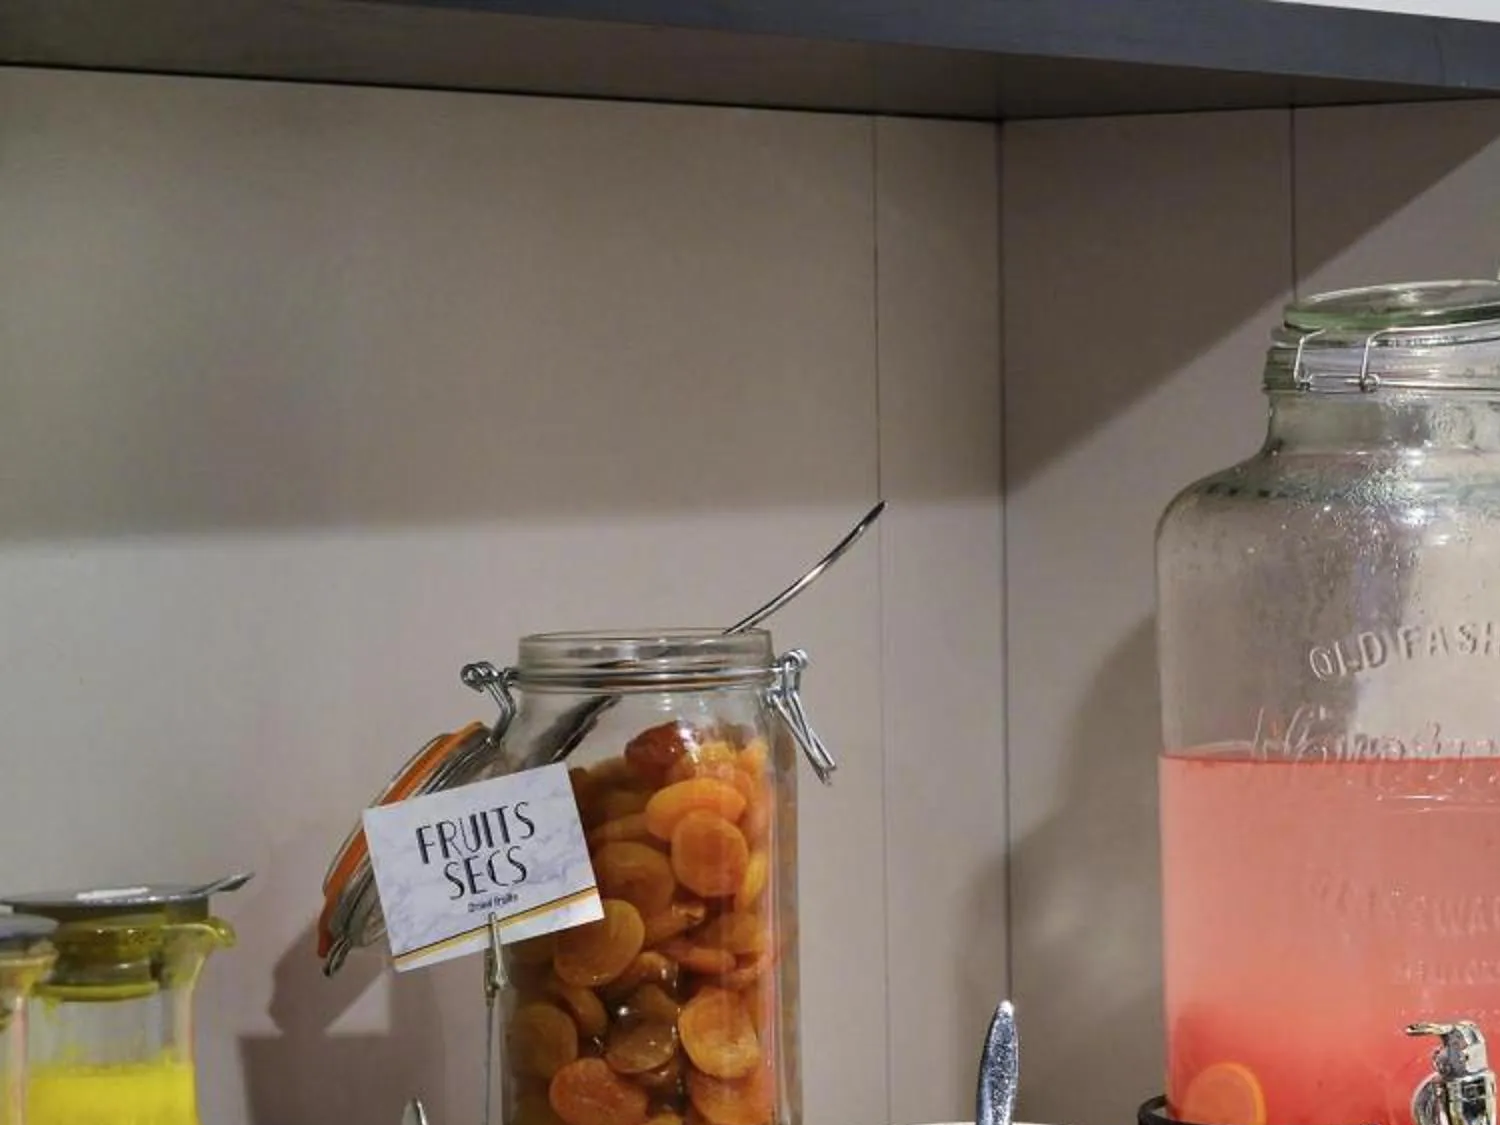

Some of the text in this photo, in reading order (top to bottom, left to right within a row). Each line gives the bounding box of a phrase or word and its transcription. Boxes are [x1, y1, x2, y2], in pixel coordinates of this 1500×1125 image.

[1309, 630, 1388, 681] OLD
[415, 801, 535, 865] FRUITS
[443, 845, 528, 901] SECS
